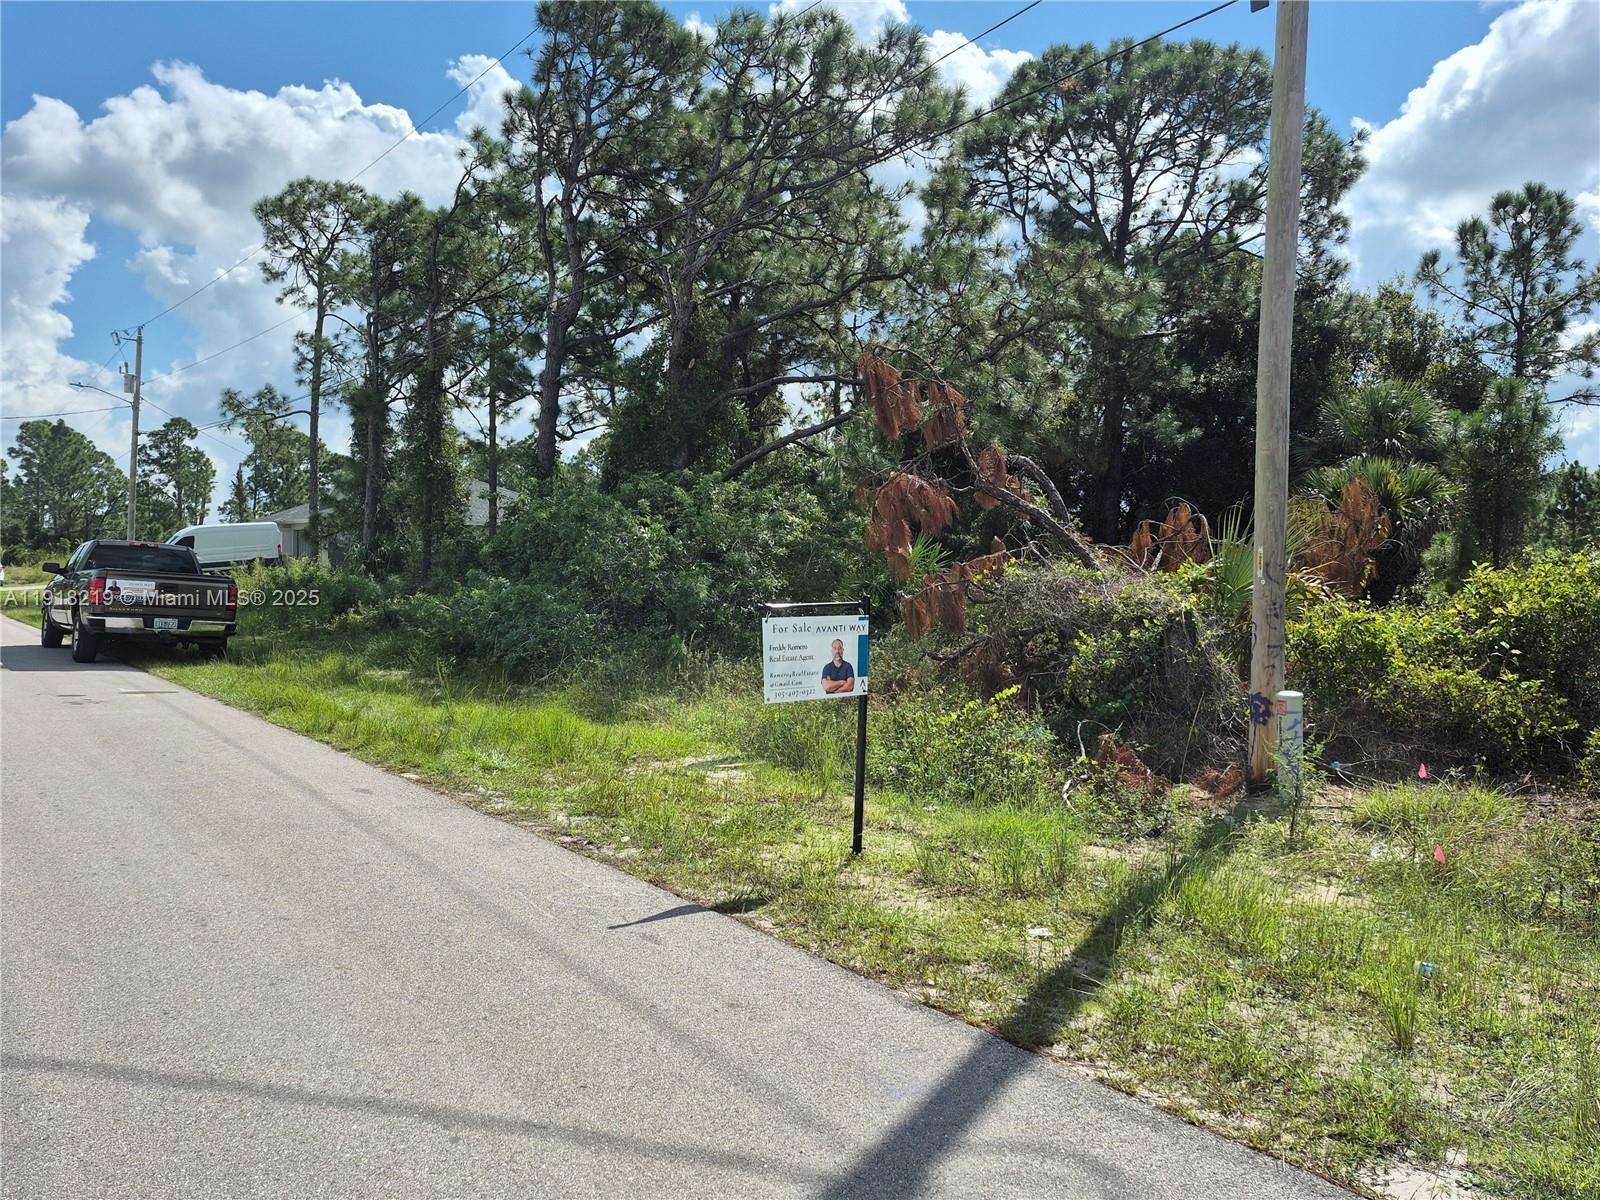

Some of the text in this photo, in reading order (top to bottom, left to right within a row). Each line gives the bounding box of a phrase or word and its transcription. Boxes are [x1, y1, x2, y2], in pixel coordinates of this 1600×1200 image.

[772, 622, 812, 634] For Sale
[816, 624, 866, 633] AVANTI WAY
[799, 654, 814, 662] Agent
